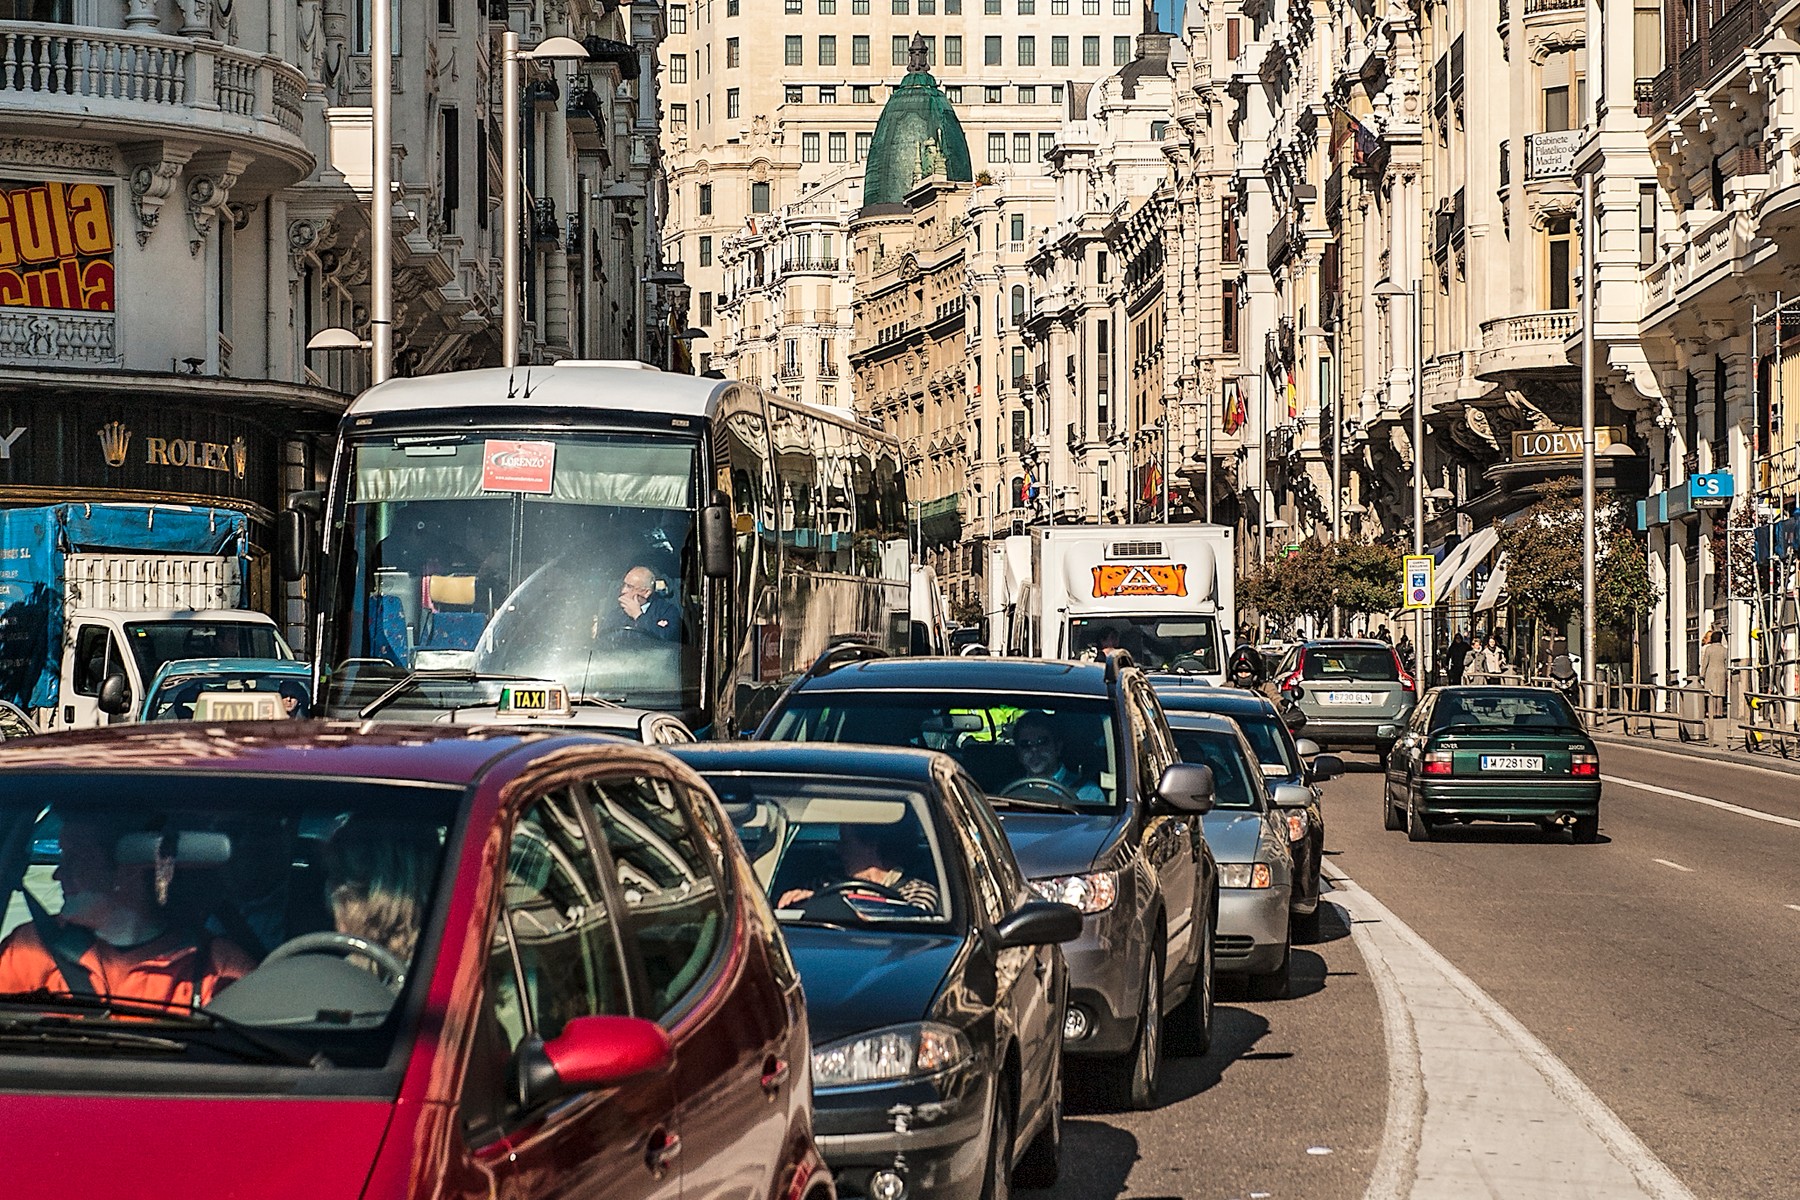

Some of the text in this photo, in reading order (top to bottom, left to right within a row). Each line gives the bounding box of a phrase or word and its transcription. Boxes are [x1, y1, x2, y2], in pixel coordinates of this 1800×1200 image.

[1535, 136, 1568, 145] Gabinete
[1535, 143, 1577, 156] Filatélico de
[1536, 155, 1562, 166] Madrid
[146, 437, 230, 472] ROLEX
[513, 691, 545, 708] TAXI
[1334, 693, 1371, 701] 6730 GLN
[213, 703, 253, 721] TAXI
[1499, 758, 1524, 769] 7281
[1526, 758, 1540, 769] SY
